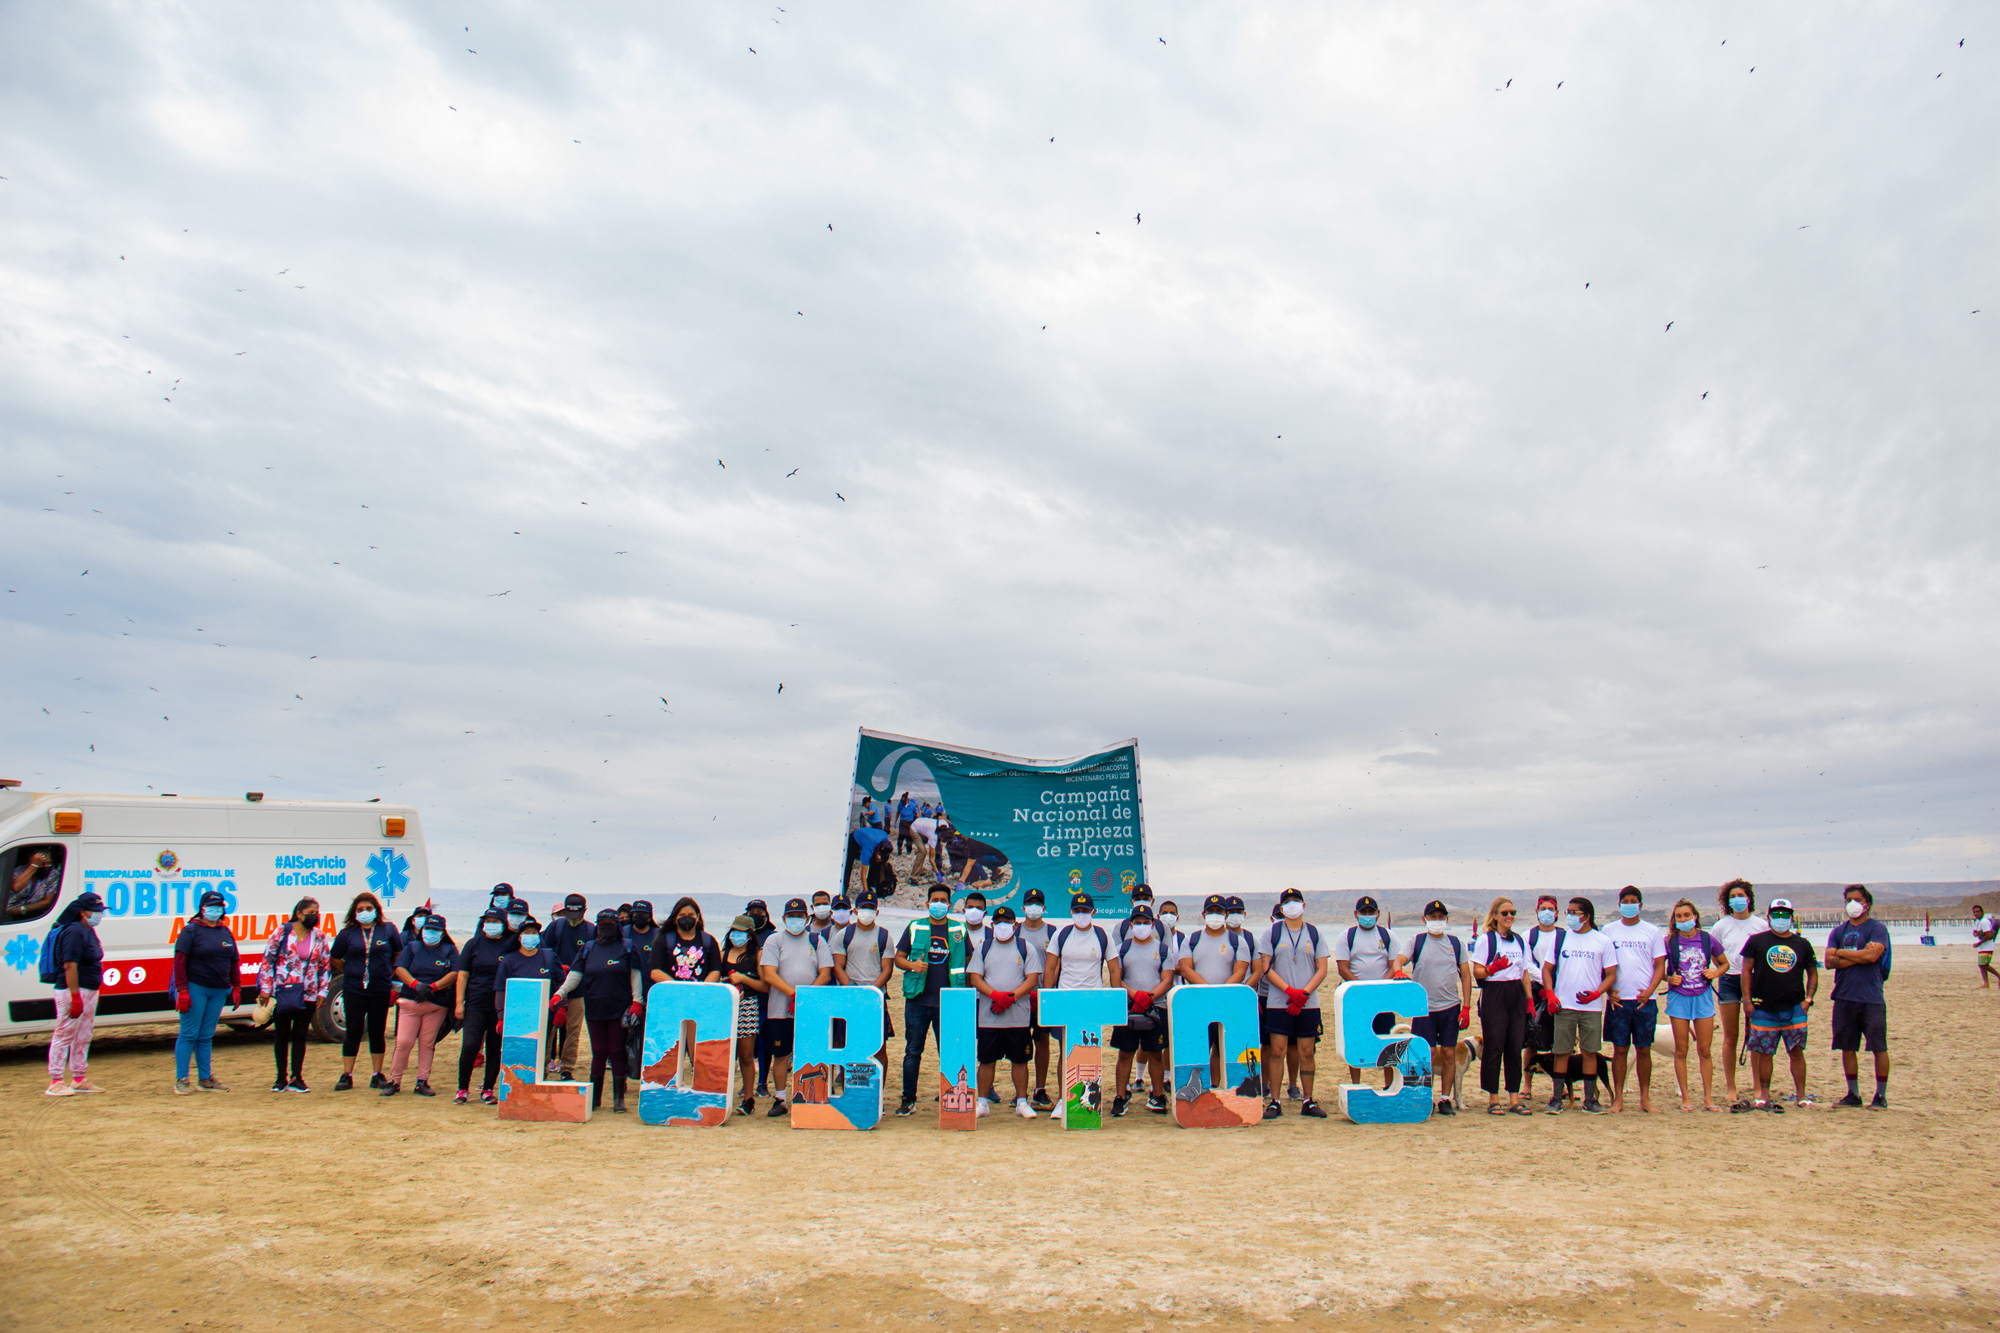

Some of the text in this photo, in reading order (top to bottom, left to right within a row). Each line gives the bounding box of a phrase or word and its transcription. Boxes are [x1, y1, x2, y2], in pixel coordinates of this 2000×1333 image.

[1065, 774, 1105, 783] BICENTENARIO
[1040, 785, 1130, 808] Campaña
[1012, 804, 1131, 822] Nacional de
[1042, 822, 1133, 843] Limpieza
[1036, 841, 1134, 861] de Playas
[84, 869, 235, 879] MUNICIPALIDAD DISTRITAL DE
[276, 872, 346, 886] deTuSalud
[498, 977, 1433, 1131] LOBITOS
